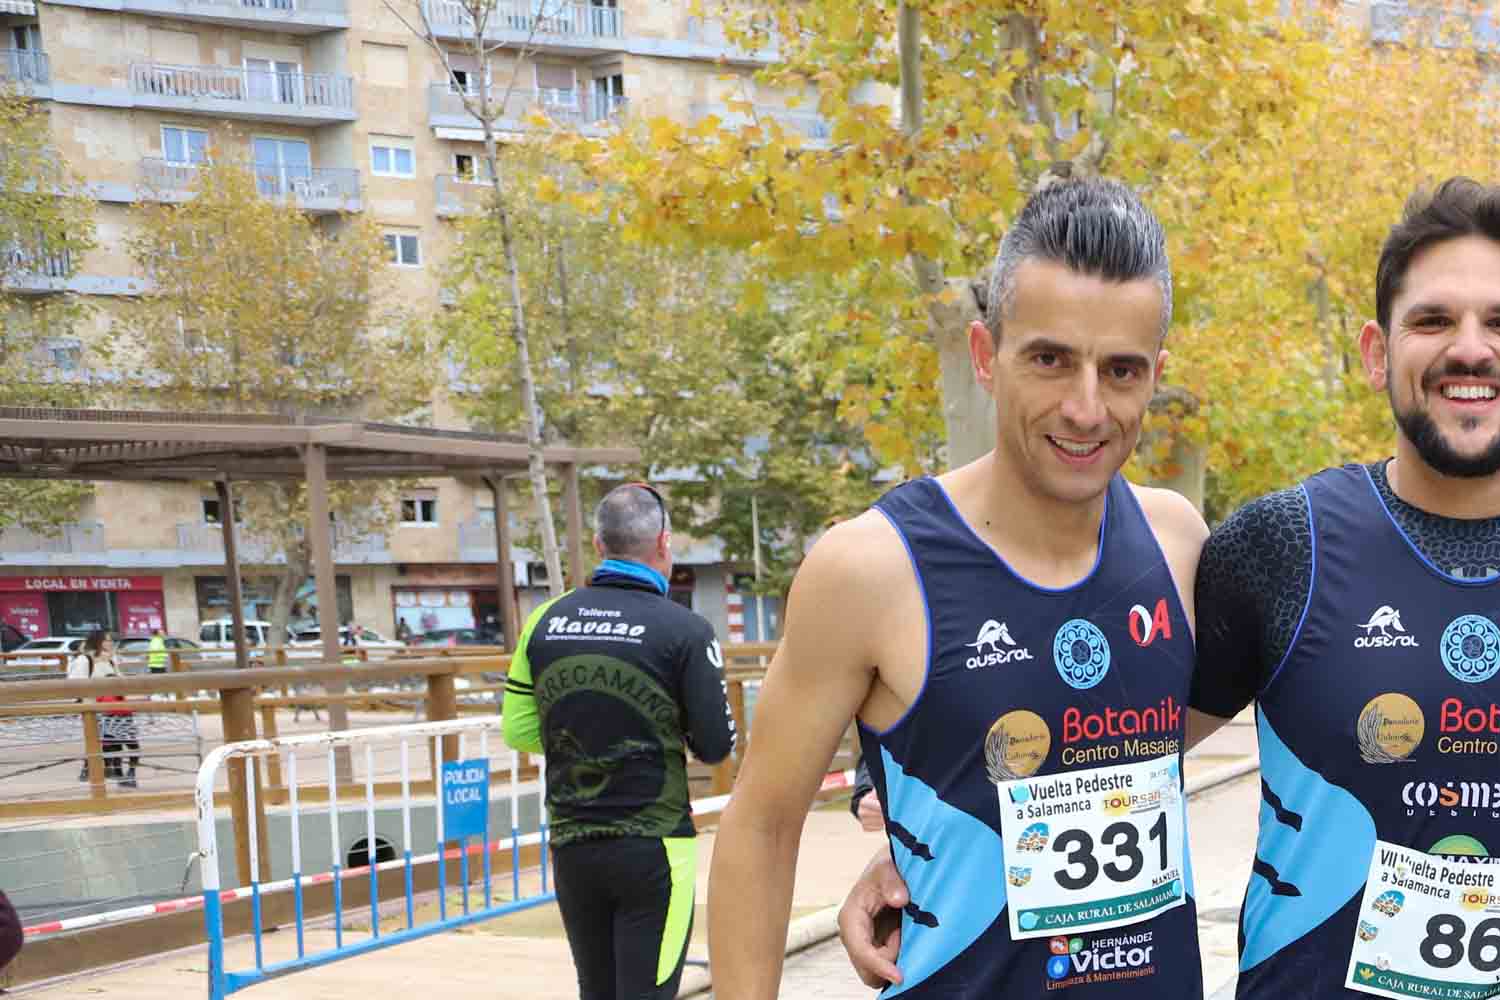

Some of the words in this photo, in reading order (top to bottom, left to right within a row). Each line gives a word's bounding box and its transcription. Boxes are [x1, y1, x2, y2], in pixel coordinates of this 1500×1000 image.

[25, 578, 66, 590] LOCAL
[70, 578, 88, 590] EN
[92, 578, 133, 590] VENTA
[1062, 696, 1182, 744] Botanik
[1062, 745, 1120, 767] Centro
[1123, 736, 1180, 758] Masajes
[1438, 736, 1499, 755] Centro
[447, 786, 482, 804] LOCAL
[1028, 778, 1073, 801] Vuelta
[1076, 773, 1134, 795] Pedestre
[1028, 799, 1092, 819] Salamanca
[1051, 811, 1168, 891] 331
[1381, 848, 1398, 868] VII
[1440, 866, 1495, 888] Pedestre
[1045, 911, 1075, 925] CAJA
[1077, 906, 1116, 921] RURAL
[1118, 903, 1131, 914] DE
[1091, 931, 1153, 949] HERNÁNDEZ
[1377, 976, 1405, 991] CAJA
[1408, 984, 1445, 997] RURAL
[1447, 988, 1462, 998] DE
